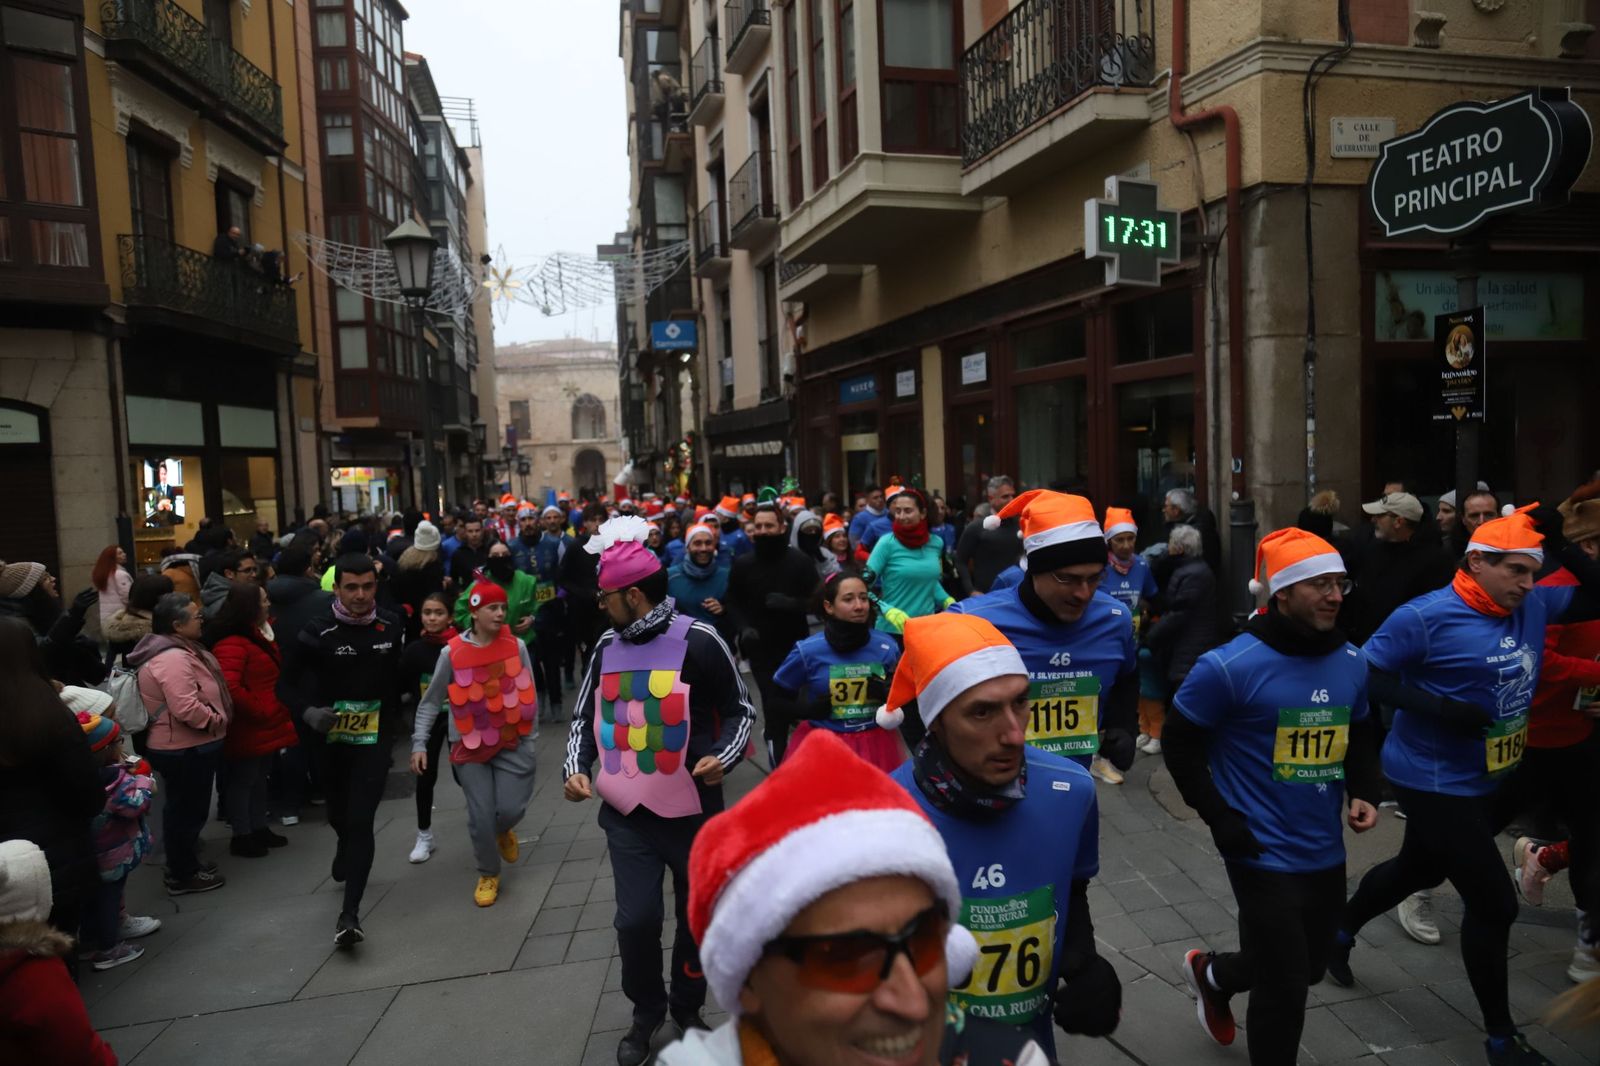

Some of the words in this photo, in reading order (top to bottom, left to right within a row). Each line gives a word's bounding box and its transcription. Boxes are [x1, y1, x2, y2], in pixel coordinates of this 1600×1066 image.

[1353, 123, 1381, 132] CALLE
[1359, 134, 1370, 142] DE
[1406, 126, 1503, 177] TEATRO
[1394, 161, 1522, 218] PRINCIPAL
[1104, 215, 1166, 248] 17:31
[1416, 281, 1431, 295] Un
[1434, 281, 1459, 296] aliad
[1488, 281, 1499, 295] la
[1503, 281, 1537, 296] salud
[1442, 300, 1456, 312] de
[1500, 636, 1517, 649] 46
[1049, 652, 1071, 666] 46
[1311, 688, 1330, 704] 46
[1030, 700, 1079, 733] 1115
[1042, 743, 1062, 753] CAJA
[1064, 740, 1095, 751] RURAL
[1288, 730, 1336, 759] 1117
[1297, 769, 1318, 778] CAJA
[972, 863, 1006, 890] 46
[970, 914, 995, 924] CAJA
[998, 909, 1029, 923] RURAL
[954, 936, 1040, 993] 76
[970, 1004, 1007, 1018] CAJA
